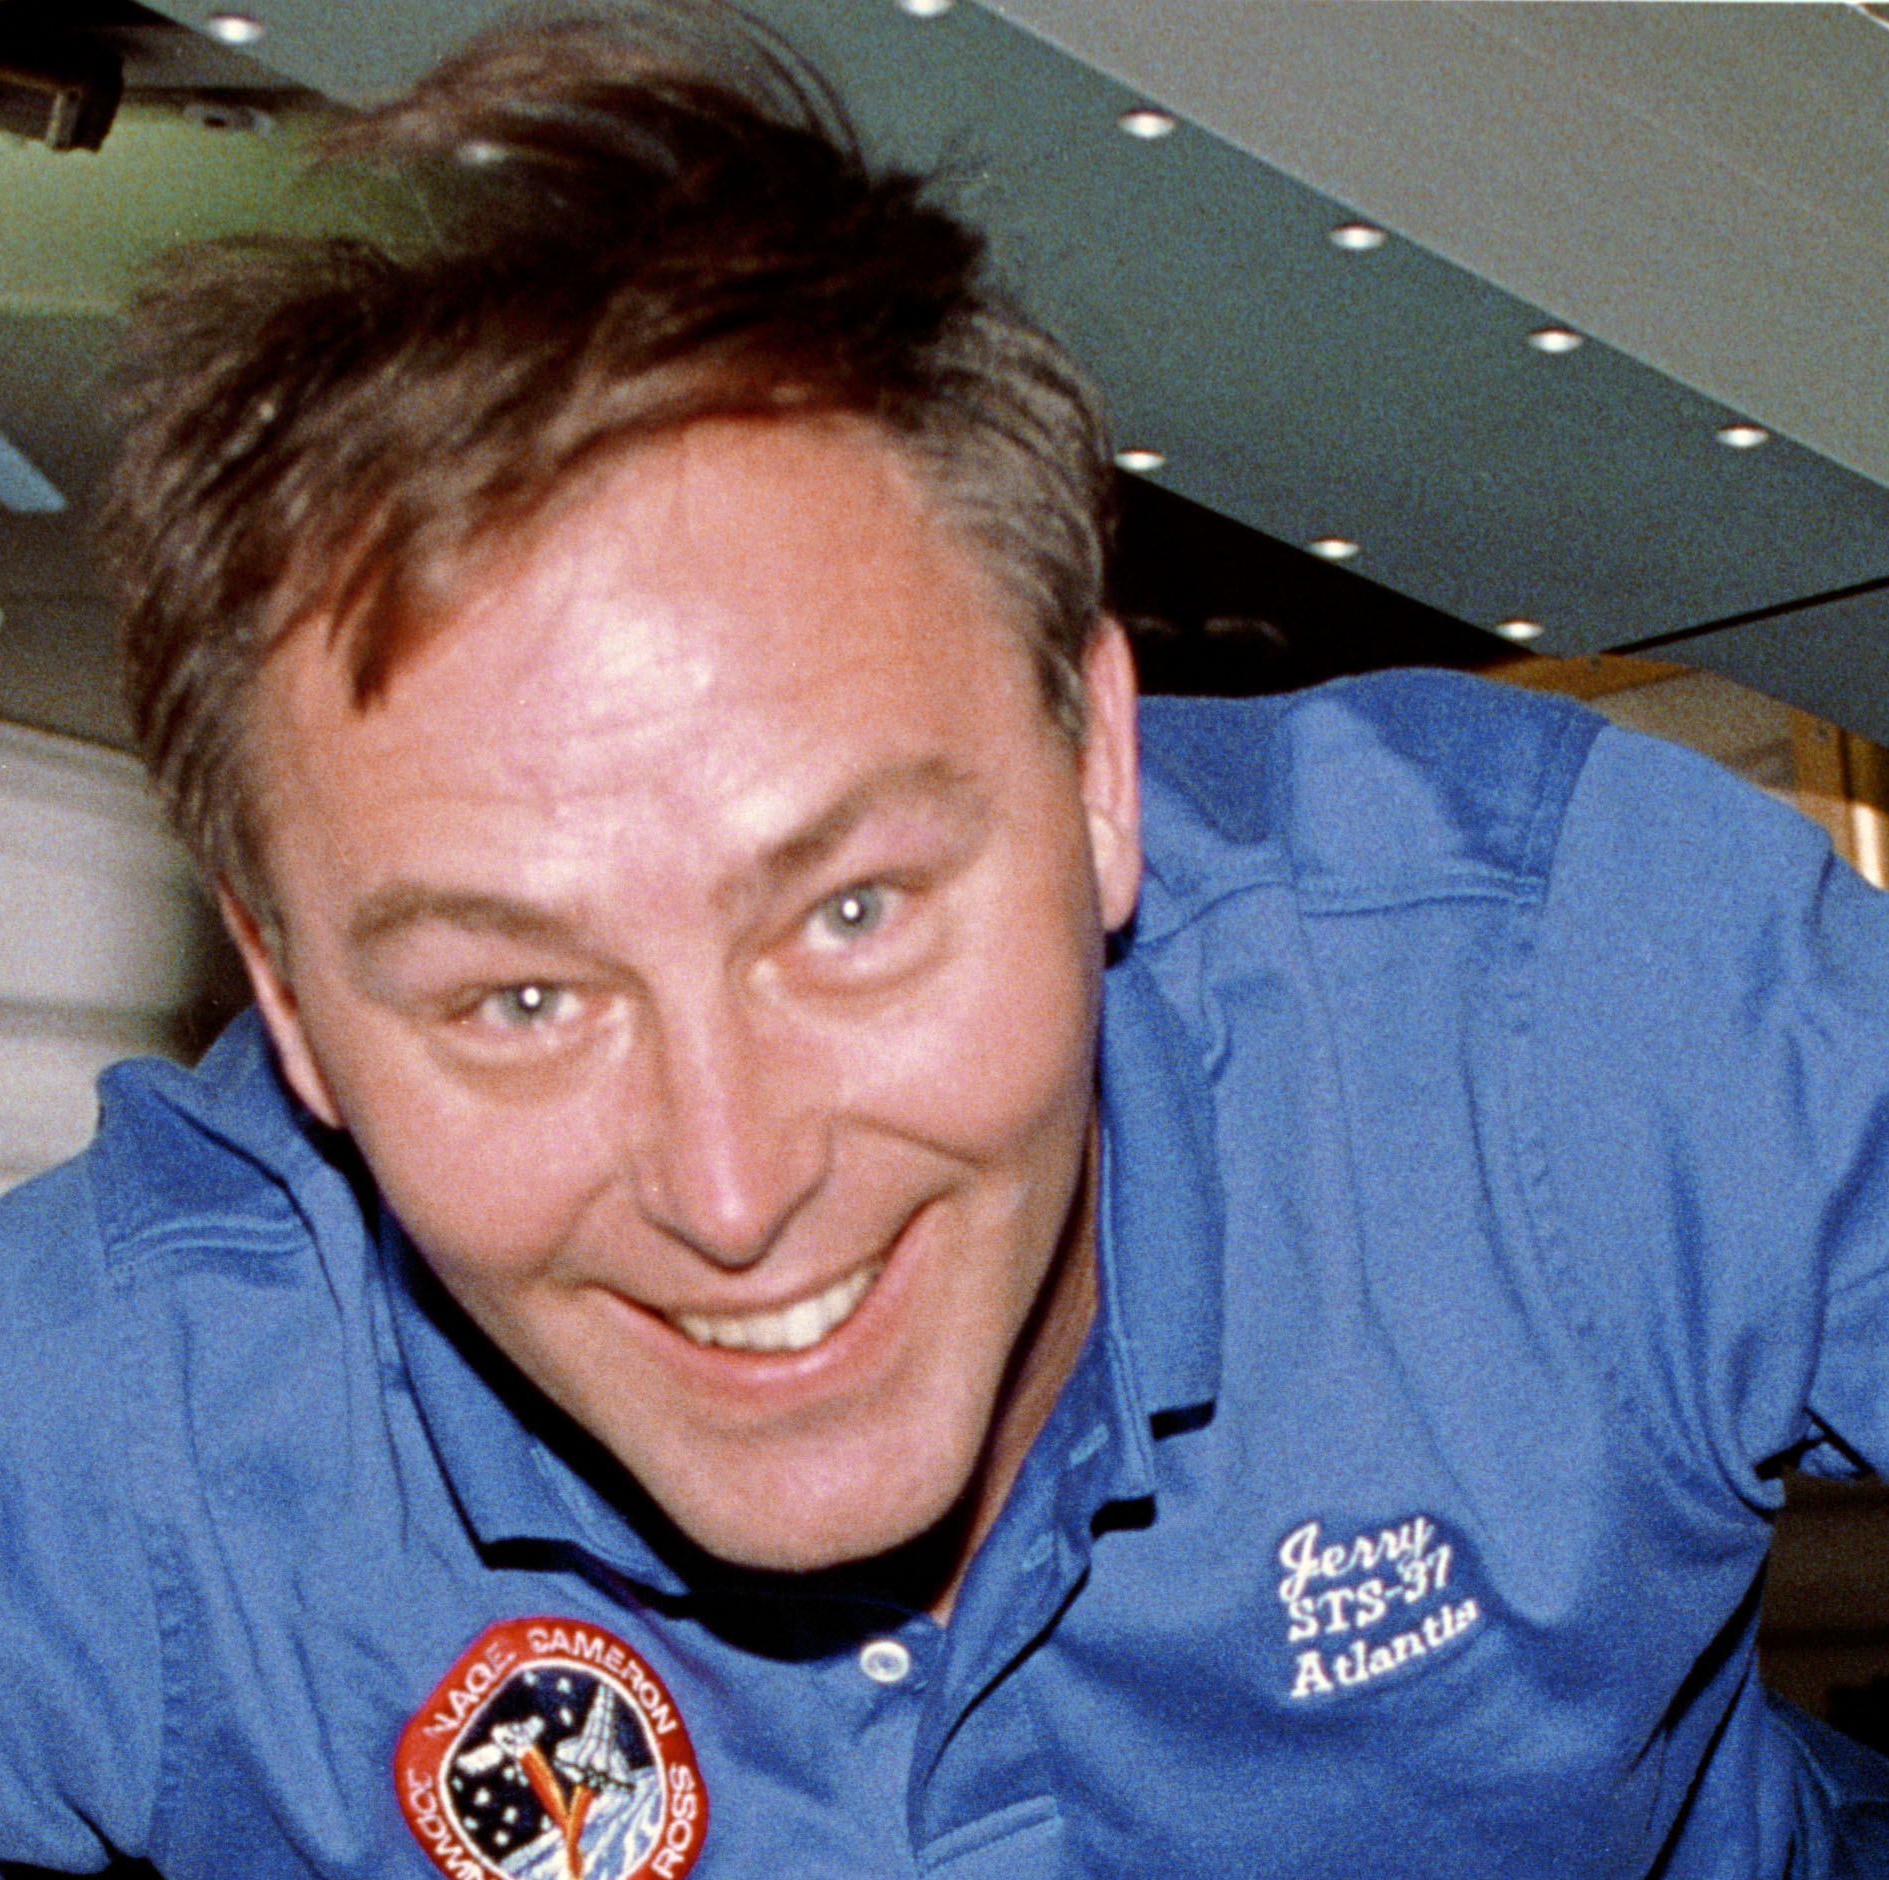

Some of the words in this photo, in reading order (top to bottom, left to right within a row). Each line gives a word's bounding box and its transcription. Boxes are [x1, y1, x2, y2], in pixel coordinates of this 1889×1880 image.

[1278, 1516, 1436, 1603] Jerry
[1288, 1544, 1452, 1641] STS-37
[422, 1641, 517, 1737] NAGE
[526, 1627, 678, 1735] CAMERON
[1291, 1598, 1480, 1699] Atlantis
[651, 1763, 699, 1880] ROSS
